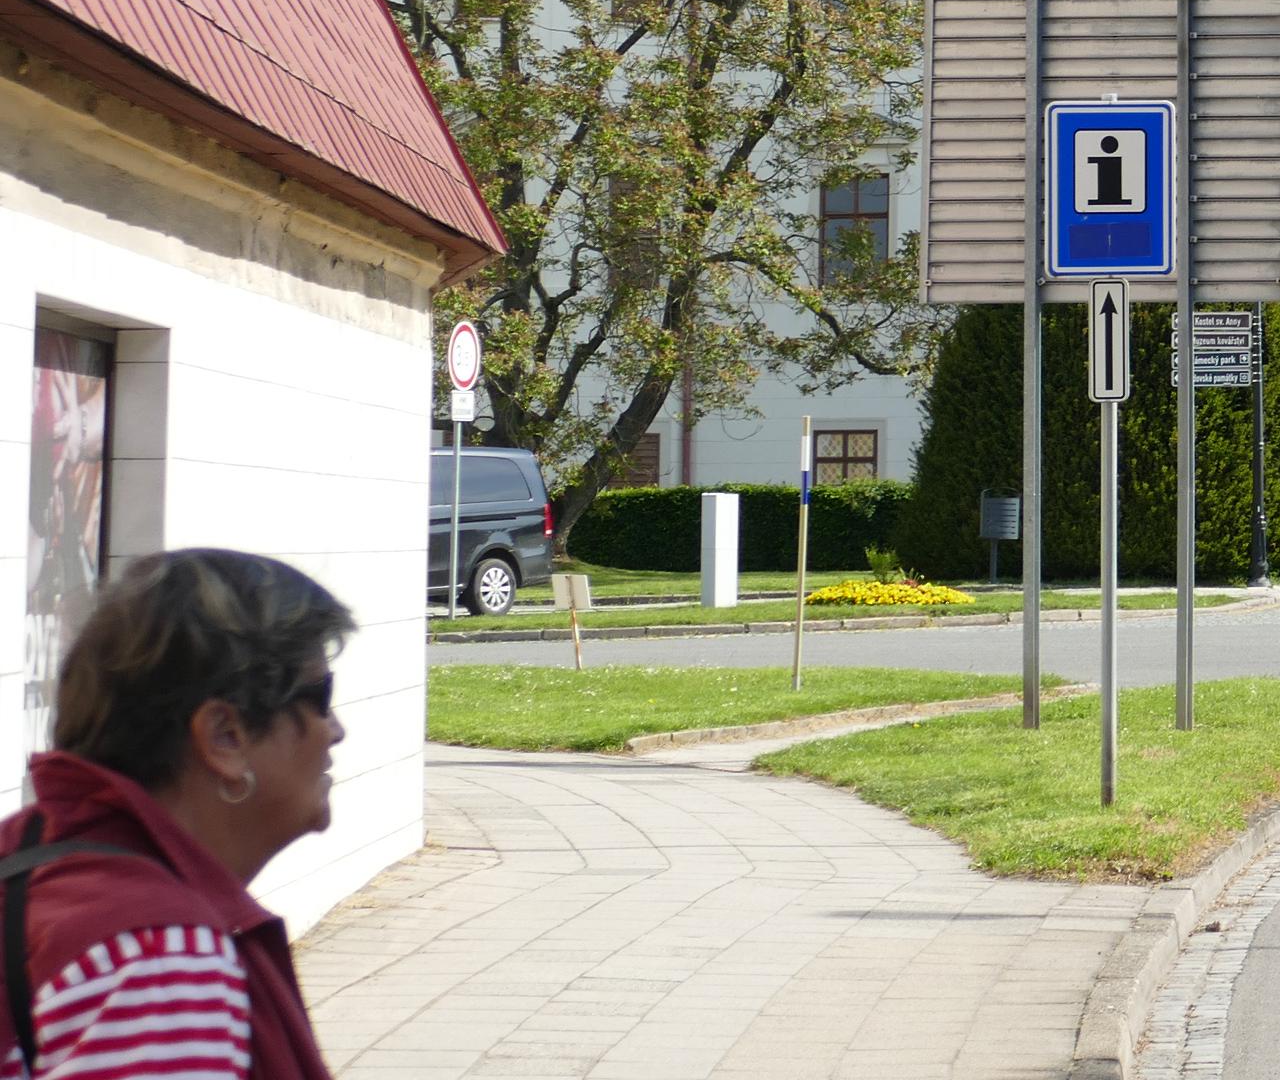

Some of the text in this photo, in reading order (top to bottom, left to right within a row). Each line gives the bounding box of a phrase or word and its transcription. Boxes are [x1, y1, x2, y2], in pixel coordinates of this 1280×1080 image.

[1194, 316, 1215, 325] Kostel
[1225, 316, 1241, 327] Anny
[1194, 355, 1236, 366] ámecký park
